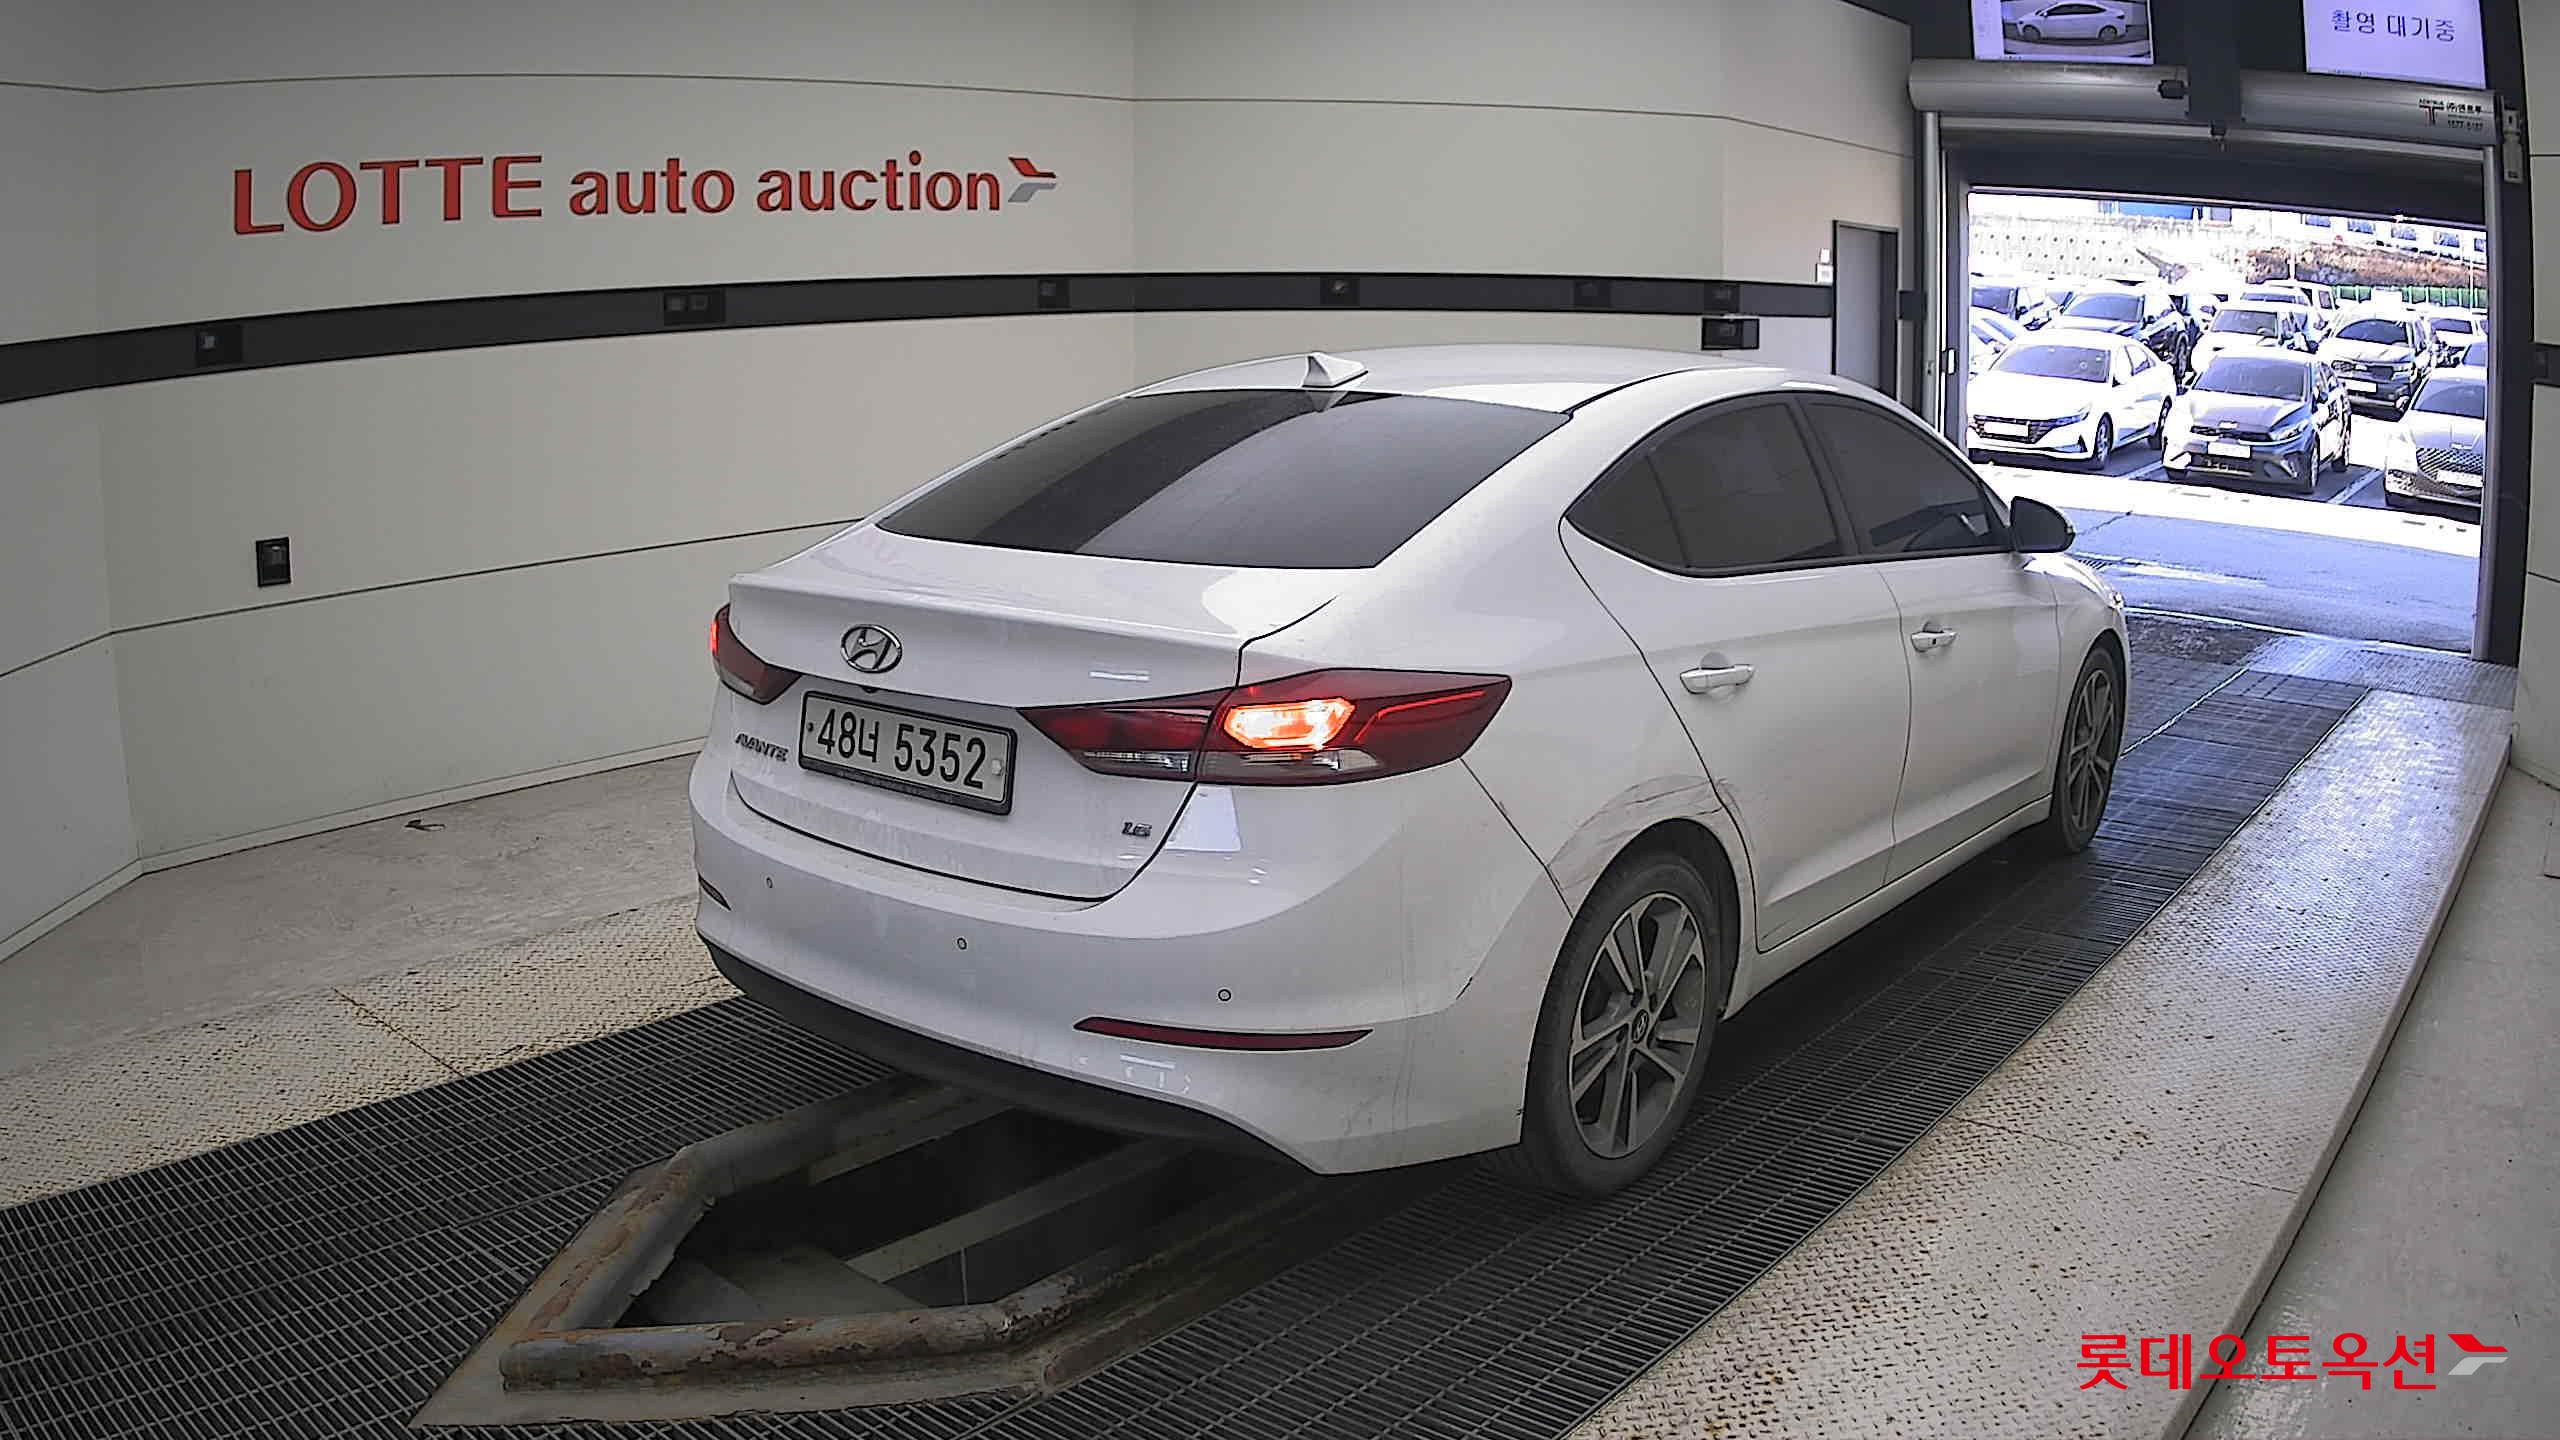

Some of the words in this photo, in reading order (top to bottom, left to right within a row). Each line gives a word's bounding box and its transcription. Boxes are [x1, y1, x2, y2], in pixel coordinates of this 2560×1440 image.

[2331, 9, 2376, 34] 촬영
[2386, 15, 2456, 42] 대기중
[234, 156, 542, 235] LOTTE
[569, 158, 734, 216] auto
[756, 150, 1001, 212] auction
[735, 732, 789, 762] AVANTE
[817, 708, 880, 763] 48너
[894, 723, 987, 790] 5352
